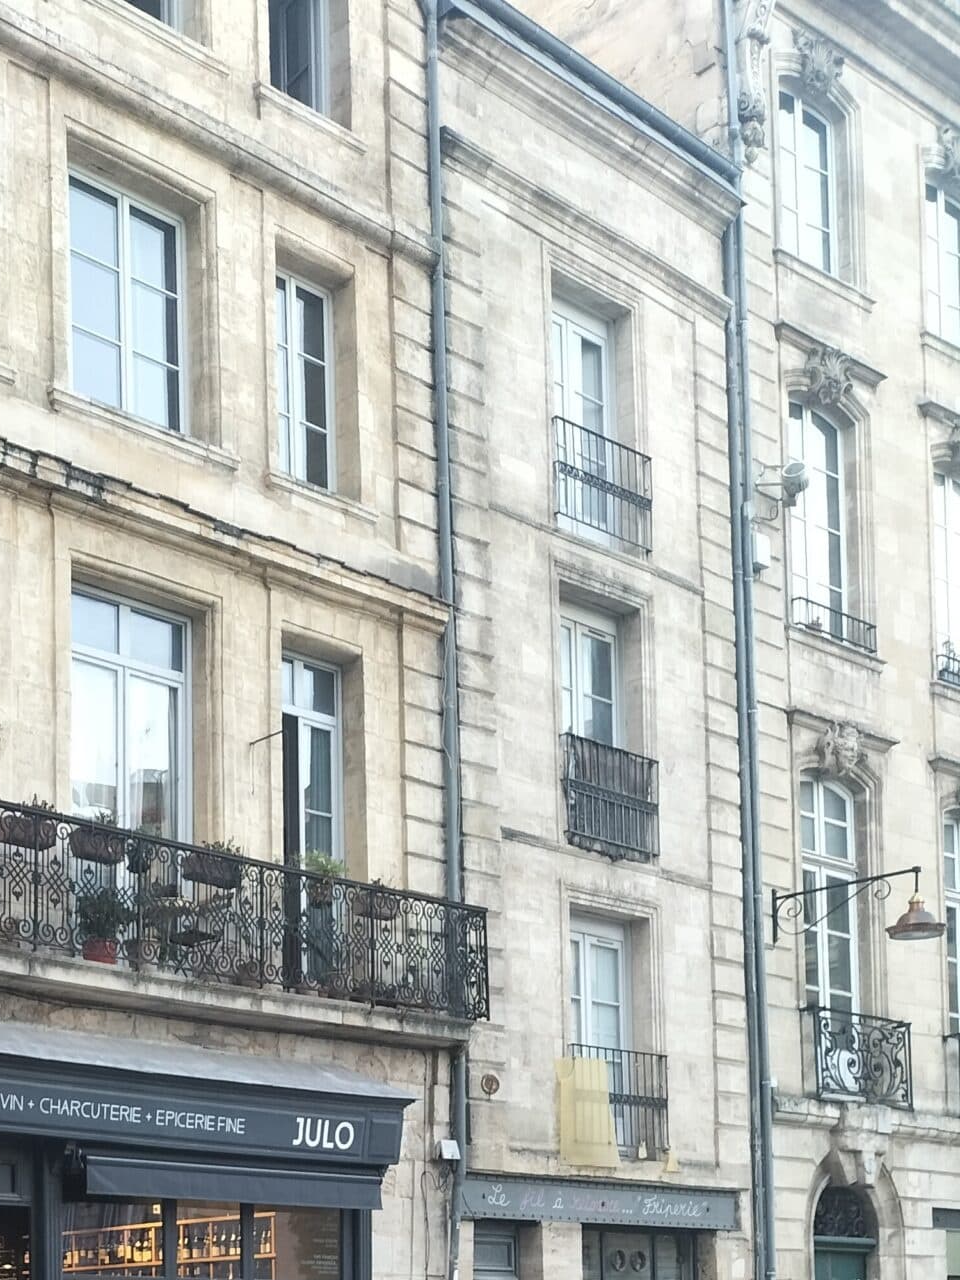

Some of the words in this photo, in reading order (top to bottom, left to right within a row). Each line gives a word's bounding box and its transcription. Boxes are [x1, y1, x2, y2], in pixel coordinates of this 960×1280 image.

[0, 1093, 24, 1112] VIN
[39, 1097, 142, 1123] CHARCUTERIE
[155, 1109, 216, 1131] EPICERIE
[217, 1116, 246, 1135] FINE
[292, 1116, 355, 1150] JULO
[487, 1183, 511, 1207] Le
